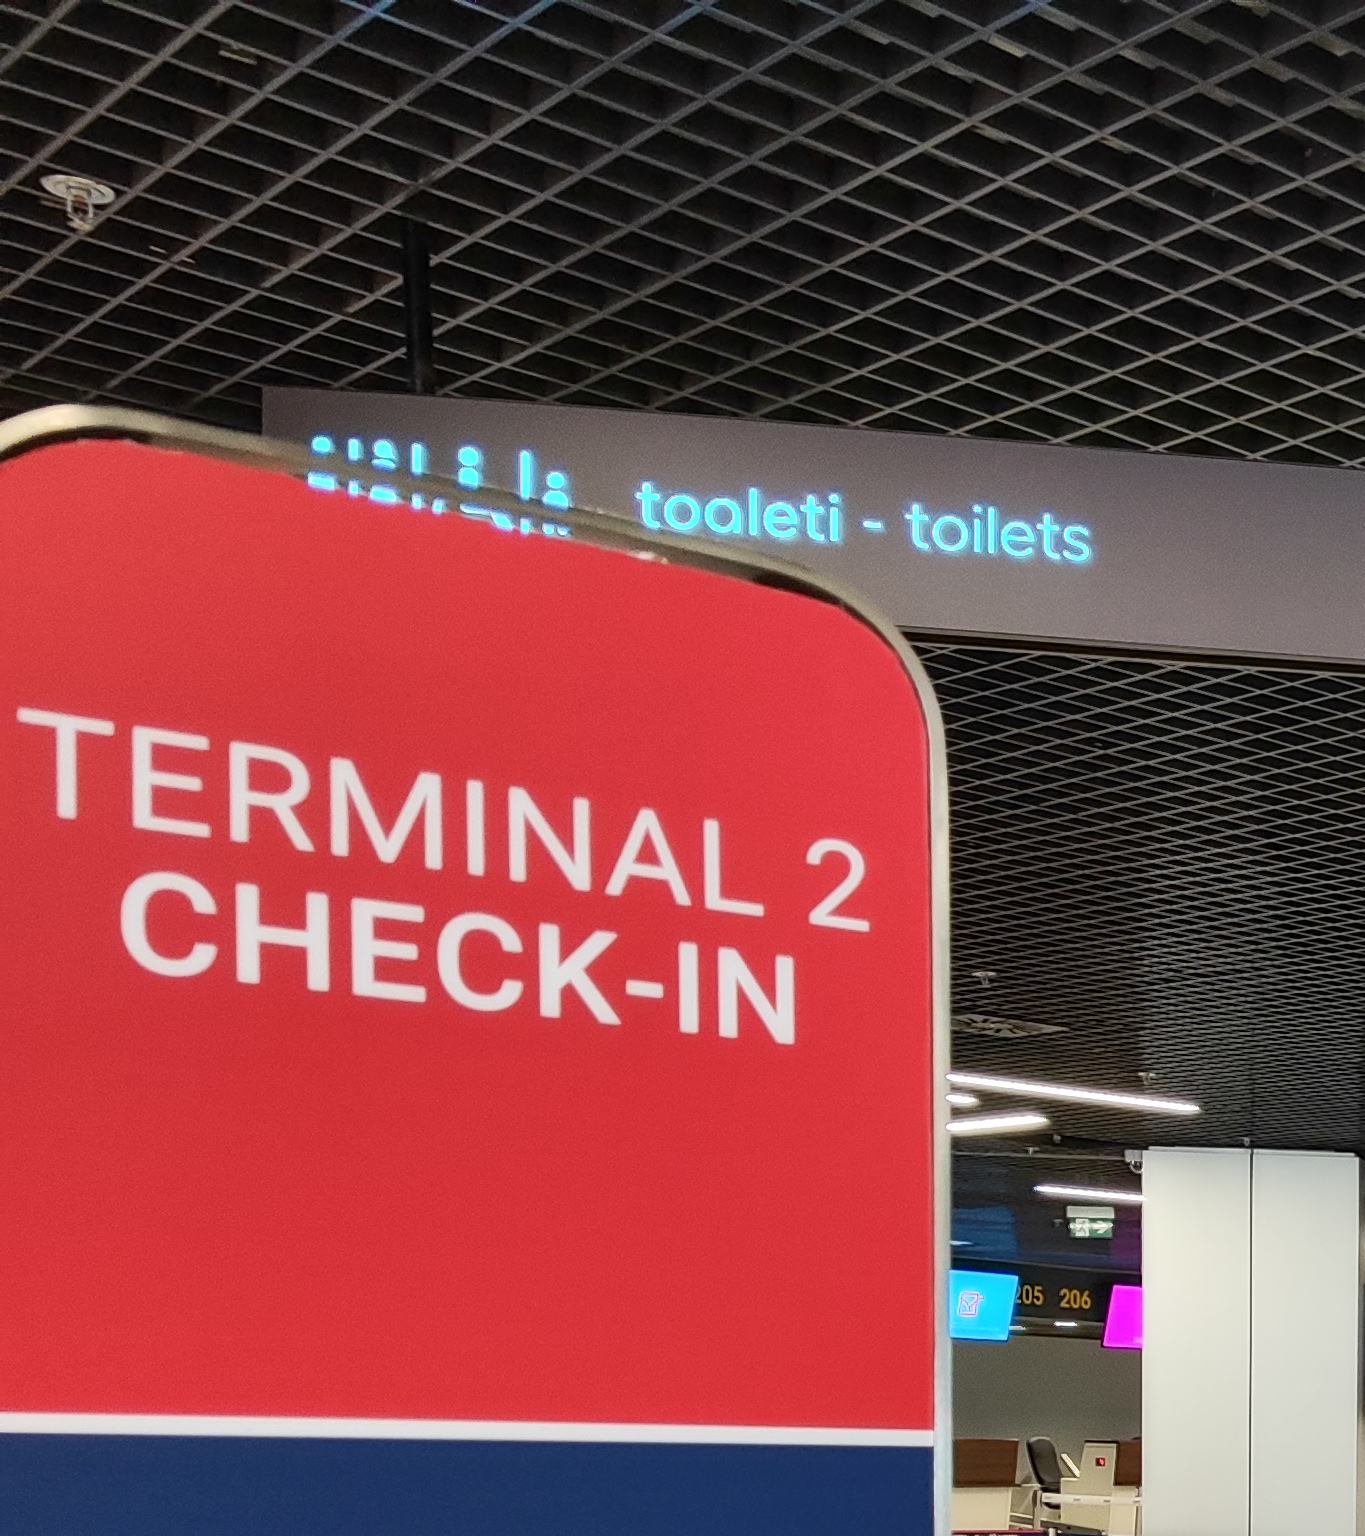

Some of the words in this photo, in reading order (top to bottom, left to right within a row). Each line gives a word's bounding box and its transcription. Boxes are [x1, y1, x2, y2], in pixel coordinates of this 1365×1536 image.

[634, 480, 843, 543] toaleti
[904, 502, 1093, 563] toilets
[16, 706, 766, 918] TERMINAL
[805, 836, 872, 933] 2
[119, 869, 798, 1047] CHECK-IN
[1058, 1287, 1092, 1310] 206
